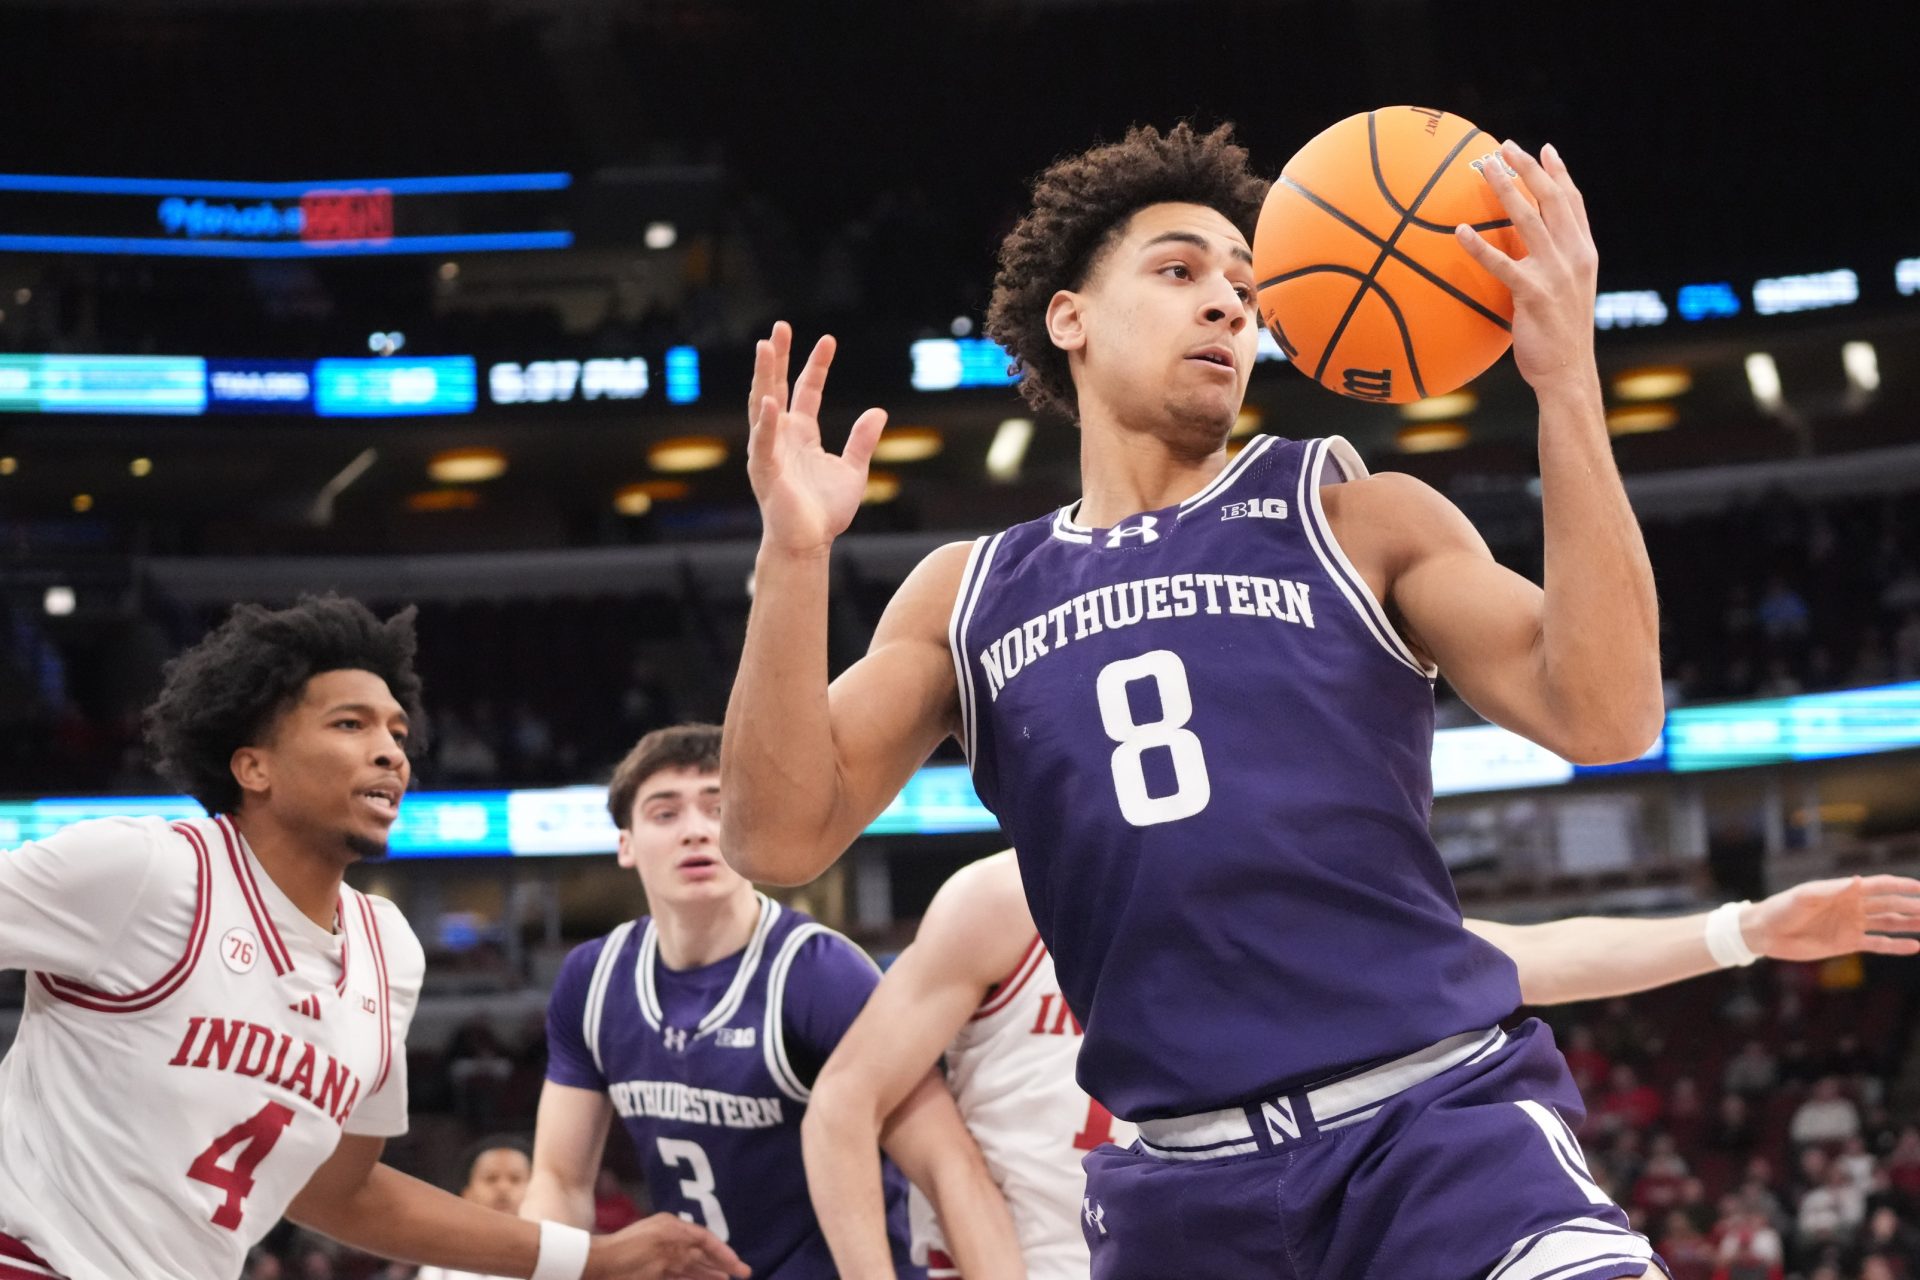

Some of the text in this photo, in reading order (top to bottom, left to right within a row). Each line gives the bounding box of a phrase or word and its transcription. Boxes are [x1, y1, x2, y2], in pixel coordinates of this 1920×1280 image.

[979, 573, 1316, 702] NORTHWESTERN
[1096, 649, 1211, 827] 8
[187, 1100, 295, 1230] 4
[1260, 1096, 1302, 1145] N
[656, 1136, 730, 1243] 3
